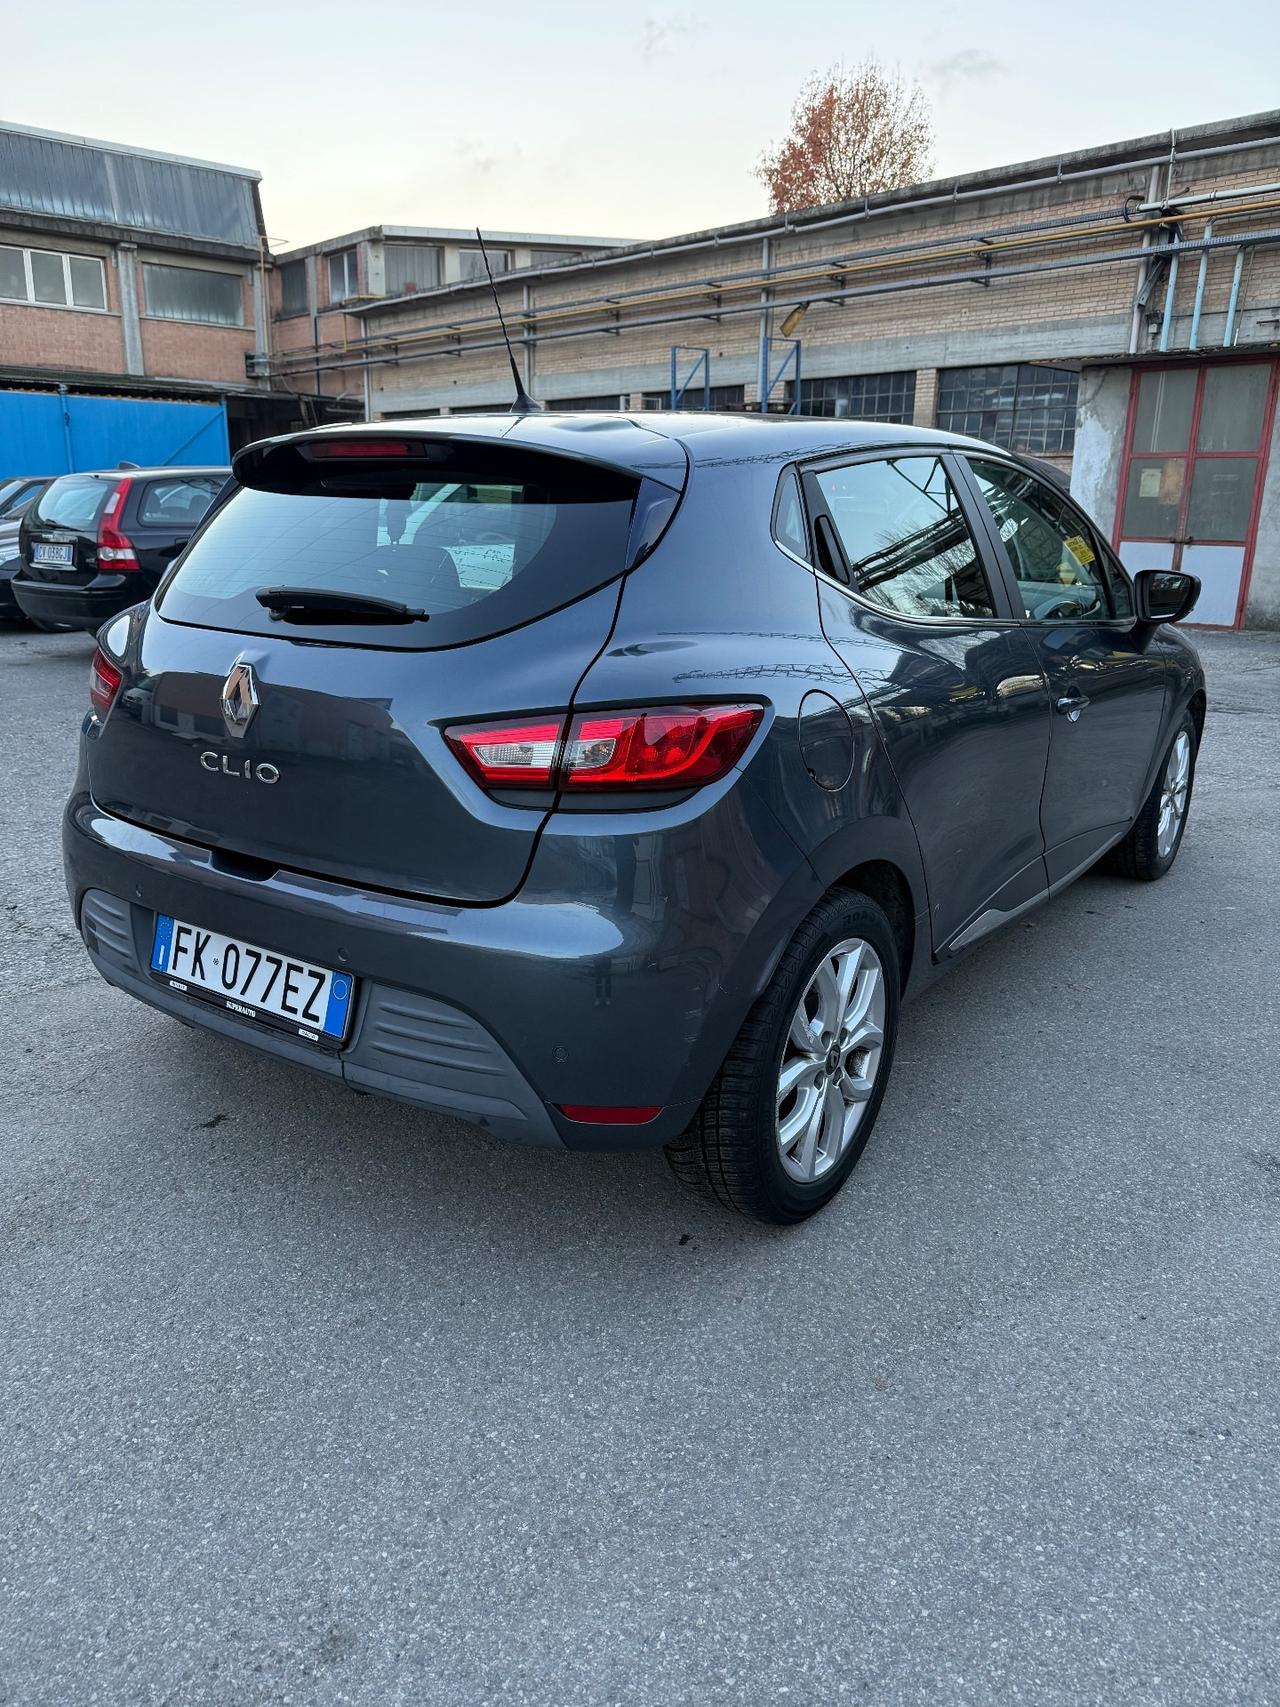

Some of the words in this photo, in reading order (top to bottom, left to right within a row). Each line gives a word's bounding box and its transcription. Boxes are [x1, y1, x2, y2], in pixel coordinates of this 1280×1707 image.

[200, 751, 280, 784] CLIO
[172, 925, 212, 981] FK
[221, 943, 326, 1023] 077EZ
[225, 1000, 256, 1018] SUPERAUTO
